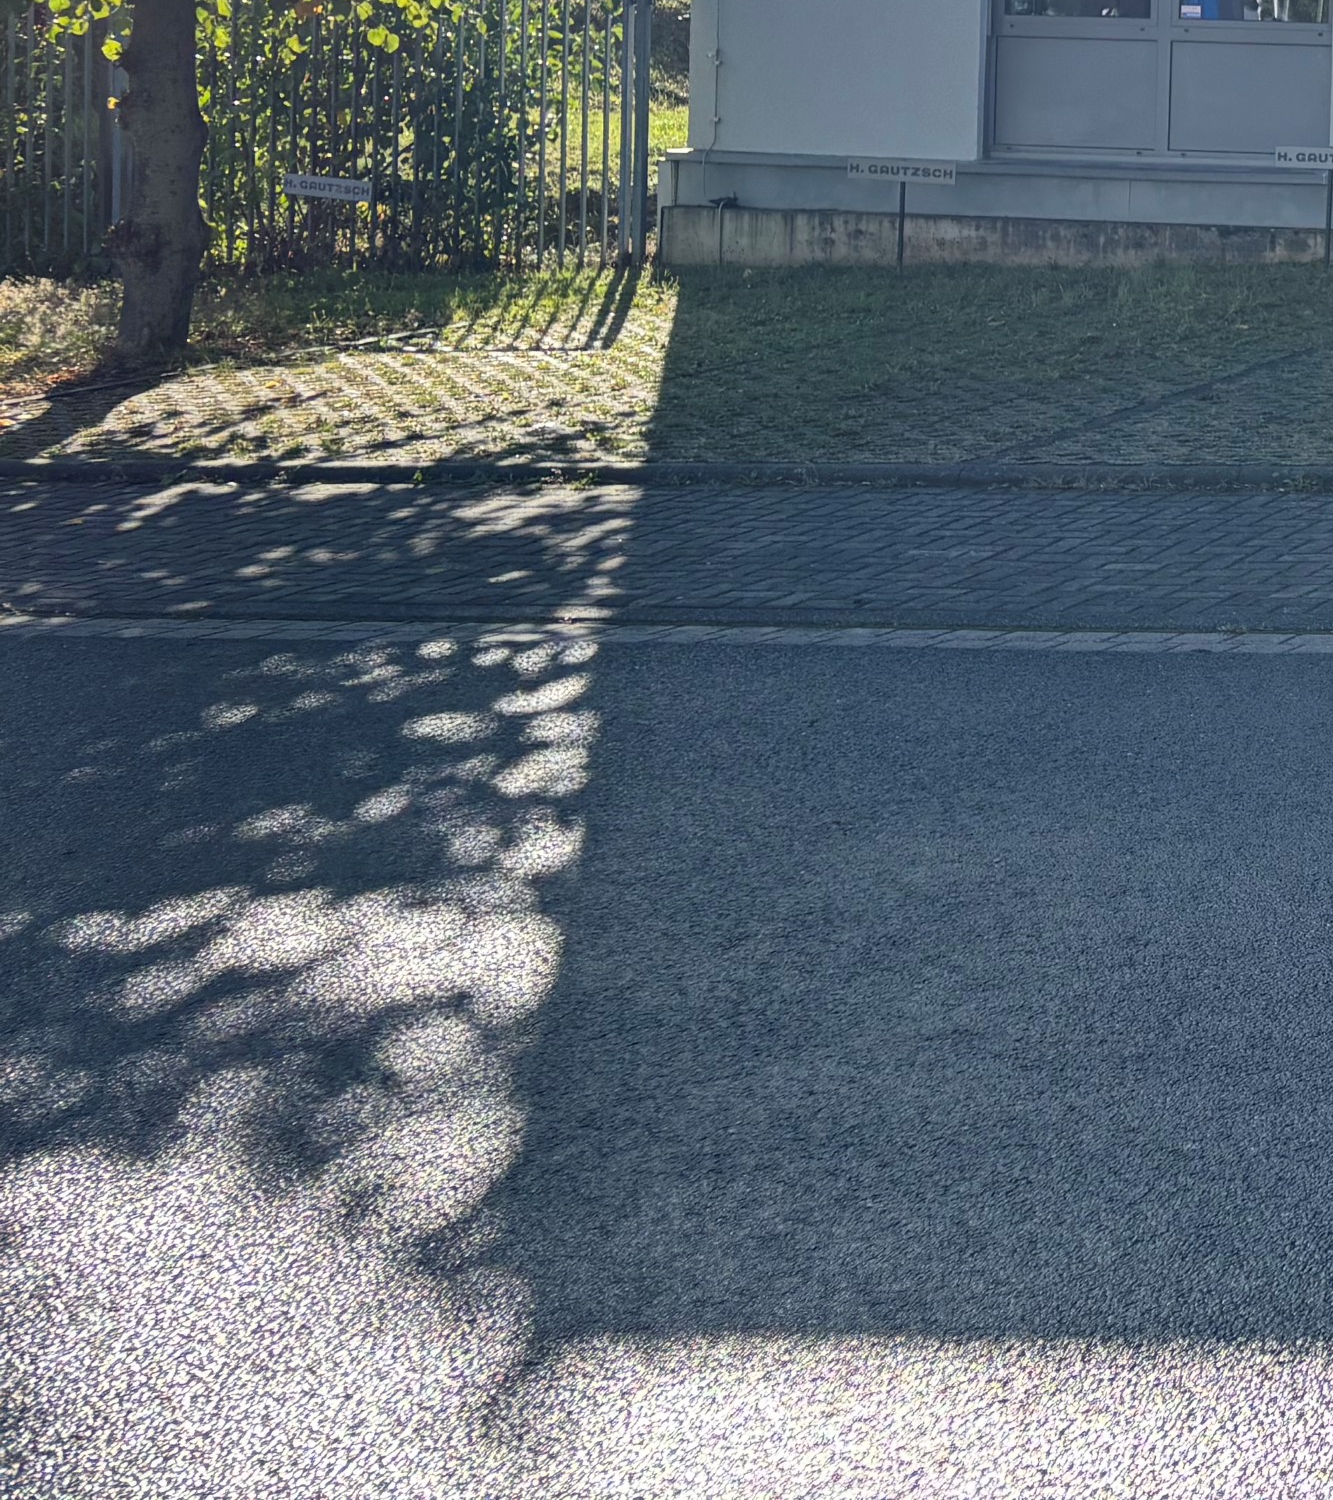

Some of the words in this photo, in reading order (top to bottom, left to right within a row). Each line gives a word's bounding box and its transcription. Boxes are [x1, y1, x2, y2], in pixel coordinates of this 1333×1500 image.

[1277, 151, 1292, 162] H.
[849, 163, 865, 173] H.
[868, 164, 953, 180] GAUTZSCH
[300, 180, 370, 196] GAUTZSCH
